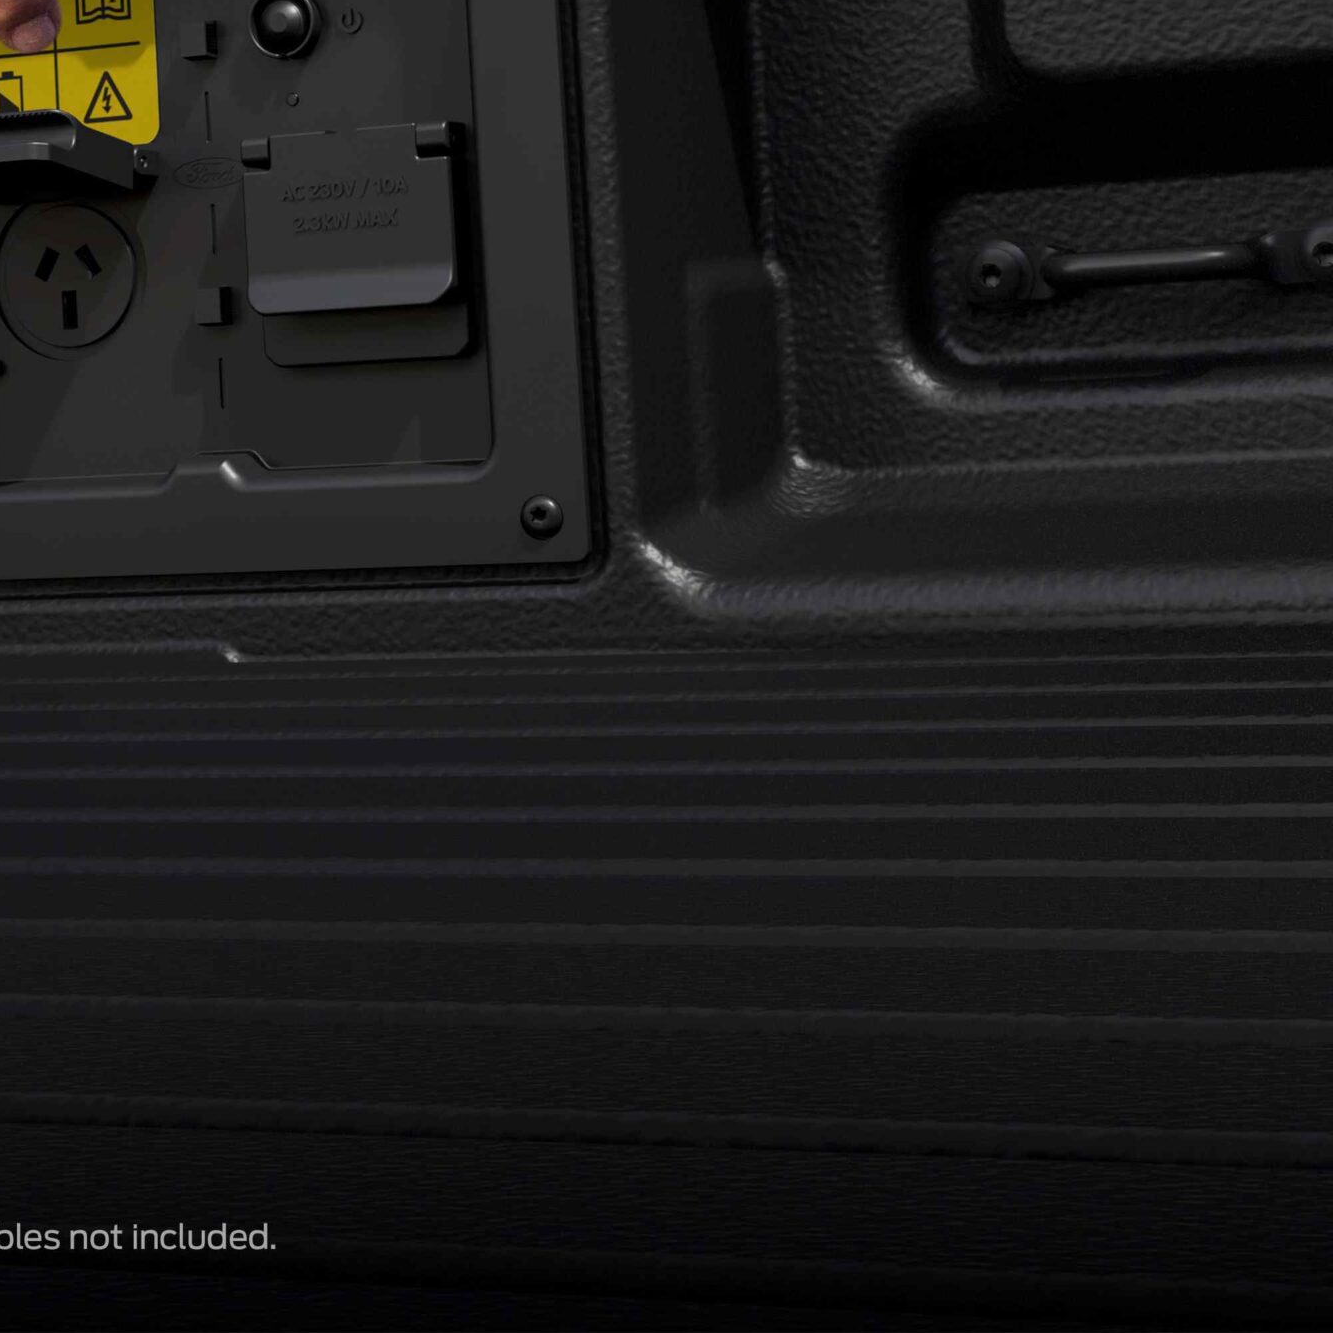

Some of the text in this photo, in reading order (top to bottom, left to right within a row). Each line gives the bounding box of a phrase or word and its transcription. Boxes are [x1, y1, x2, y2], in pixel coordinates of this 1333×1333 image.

[280, 185, 306, 202] AC
[308, 179, 357, 202] 230V
[372, 176, 409, 196] 10A
[353, 207, 399, 228] MAX
